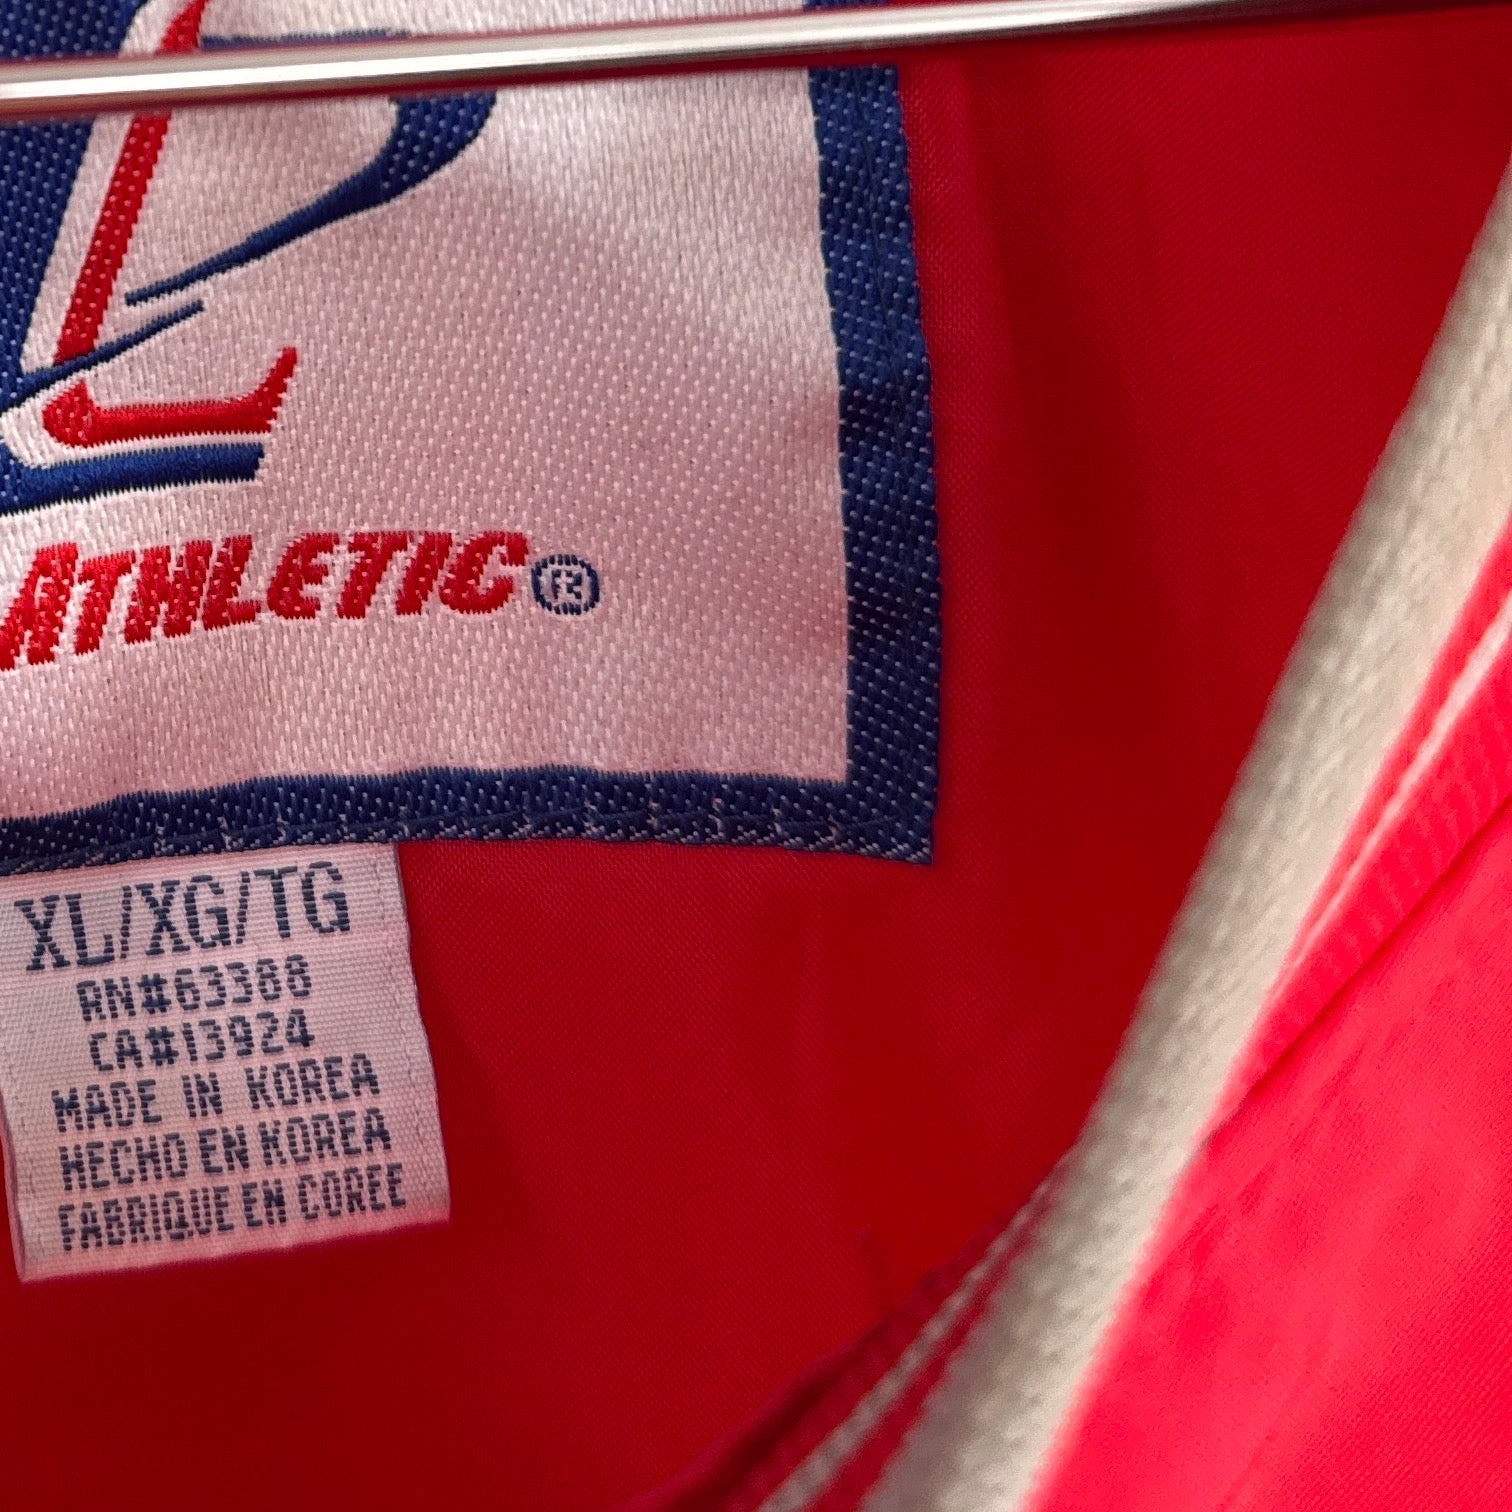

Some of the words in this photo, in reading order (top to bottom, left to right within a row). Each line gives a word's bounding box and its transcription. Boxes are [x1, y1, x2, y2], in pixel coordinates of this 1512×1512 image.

[14, 860, 351, 971] XL/XG/TG
[76, 955, 312, 1021] RN#63388
[89, 1009, 315, 1071] CA#13924
[51, 1079, 162, 1133] MADE
[182, 1071, 223, 1118] IN
[244, 1053, 380, 1110] KOREA
[58, 1132, 188, 1191] HECHO
[198, 1125, 249, 1174] EN
[258, 1107, 392, 1168] KOREA
[58, 1186, 235, 1251] FABRIQUE
[242, 1180, 287, 1230] EN
[298, 1163, 407, 1220] COREE
